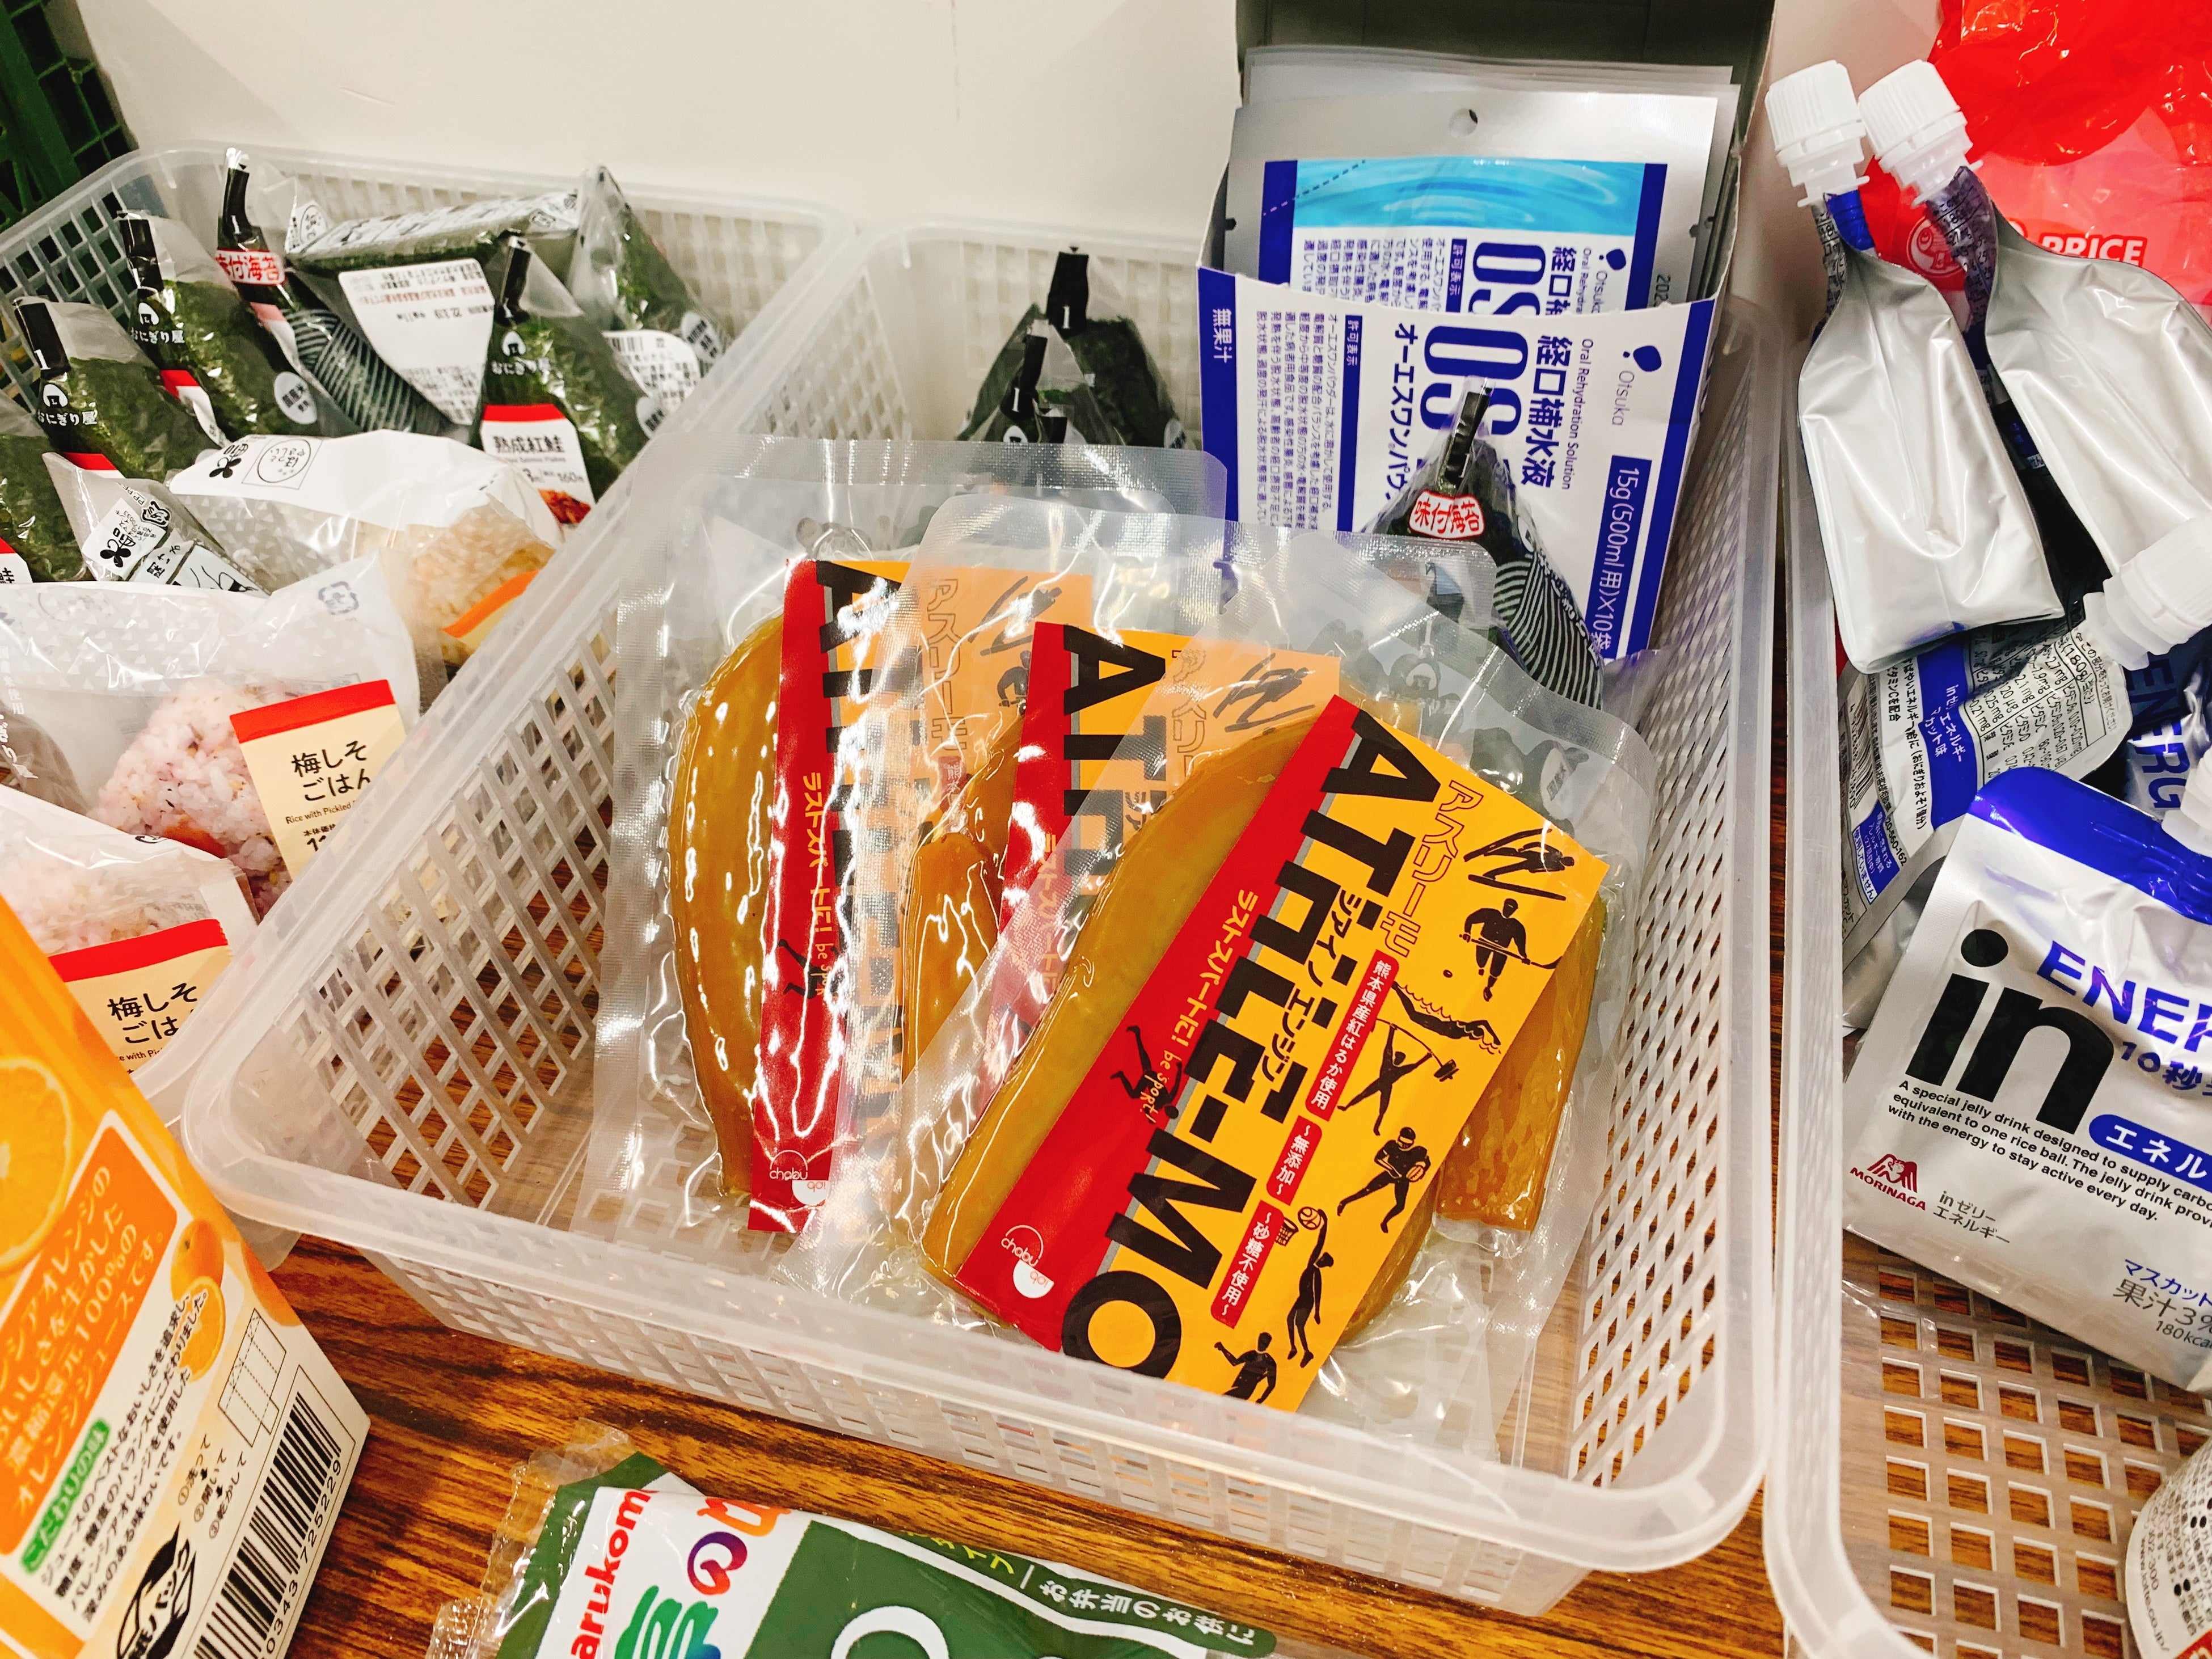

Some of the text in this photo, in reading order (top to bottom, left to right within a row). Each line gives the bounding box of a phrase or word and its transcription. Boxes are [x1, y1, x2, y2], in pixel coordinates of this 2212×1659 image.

[1581, 247, 1592, 269] Oral
[1212, 308, 1232, 363] 無果汁
[1346, 319, 1361, 366] 許可表示
[37, 410, 97, 425] おにぎり屋
[1521, 334, 1573, 489] 経口補水液
[1561, 338, 1594, 490] Oral Rehydration Solution
[1611, 370, 1635, 426] Otsuka
[1413, 497, 1482, 534] 味付海苔
[292, 740, 366, 777] 梅しそ
[285, 802, 352, 825] Rice with Pickled
[1380, 780, 1483, 959] アスリーモ
[107, 982, 197, 1021] 梅しそ
[123, 1016, 180, 1044] ごは
[1311, 959, 1391, 1111] 熊本県産紅はるか使用
[1906, 928, 2116, 1135] in
[126, 1052, 146, 1061] with
[1160, 1049, 1182, 1070] be
[1893, 1092, 1962, 1127] equivalent
[1965, 1115, 1979, 1129] to
[1981, 1124, 2008, 1141] one
[2010, 1135, 2037, 1153] rice
[2040, 1146, 2069, 1167] ball.
[2071, 1158, 2097, 1177] The
[2097, 1171, 2132, 1194] jelly
[2134, 1183, 2173, 1209] drink
[1899, 1080, 1909, 1091] A
[1911, 1085, 1960, 1114] special
[1961, 1099, 1991, 1120] jelly
[1994, 1111, 2031, 1135] drink
[2033, 1127, 2100, 1163] designed
[2102, 1155, 2117, 1170] to
[2120, 1162, 2170, 1193] supply
[769, 1166, 808, 1181] chabu
[1888, 1103, 2159, 1222] with the energy to stay active every day.
[1850, 1167, 1926, 1211] MORINAGA
[1933, 1206, 2010, 1244] エネルギー
[1001, 1237, 1039, 1267] chabu
[10, 1229, 165, 1517] オレンジジュースです。
